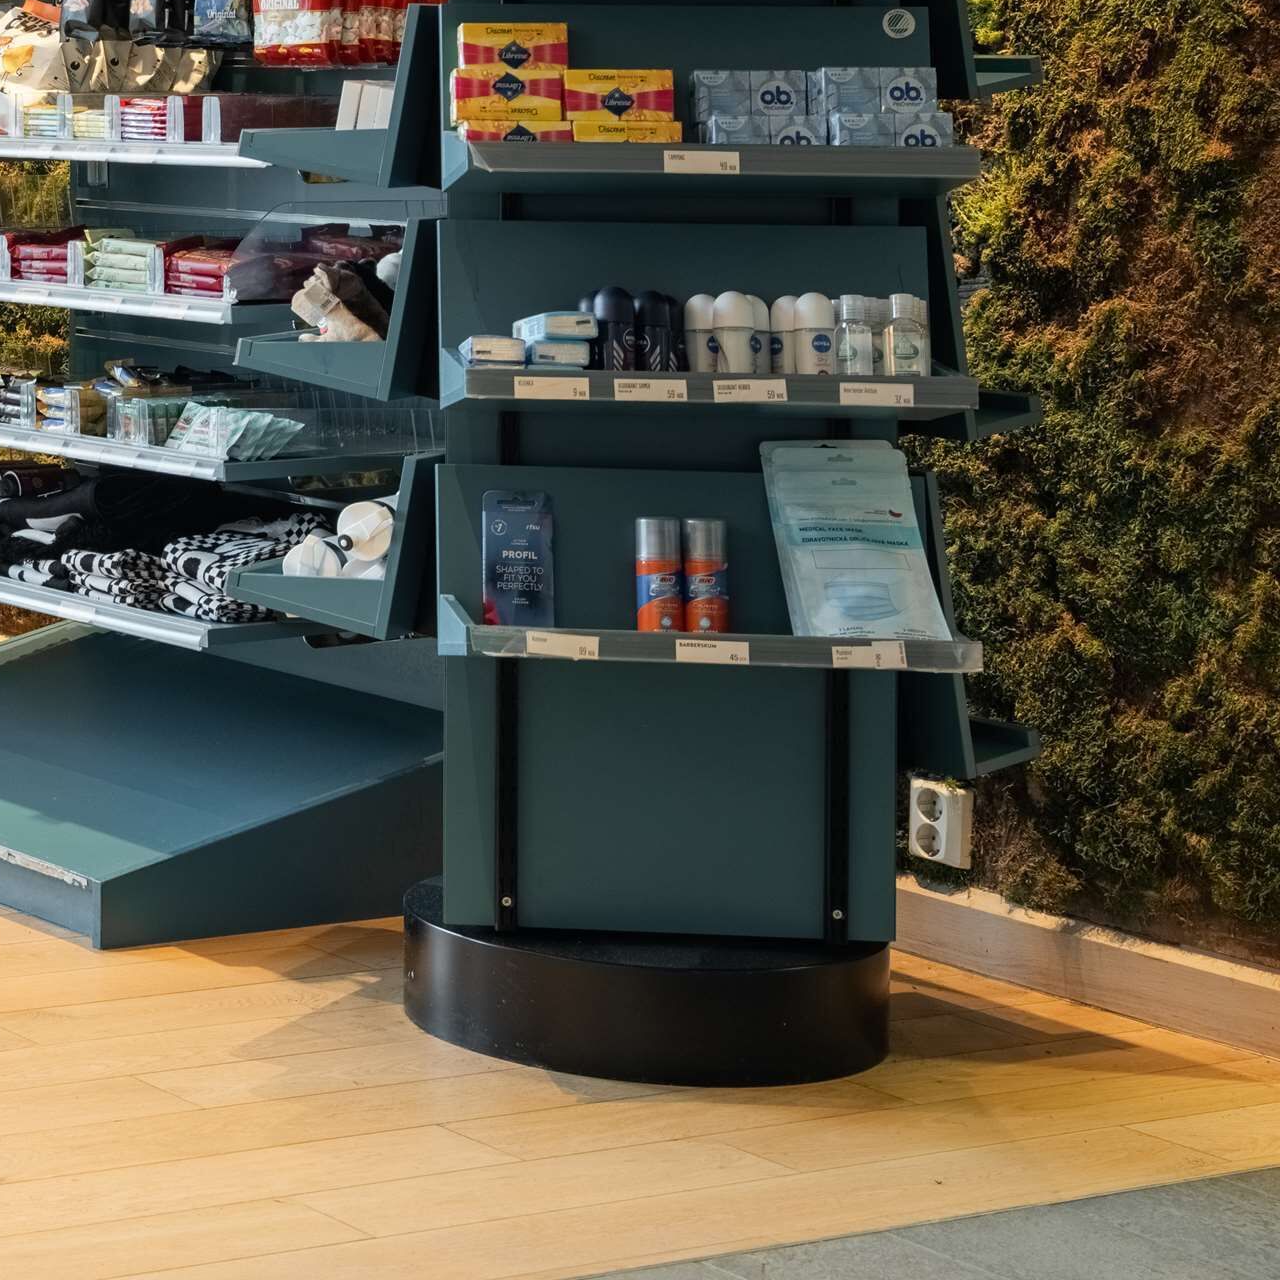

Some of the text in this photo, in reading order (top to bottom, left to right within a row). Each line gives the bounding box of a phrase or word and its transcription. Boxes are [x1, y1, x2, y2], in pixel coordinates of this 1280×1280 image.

[760, 85, 793, 105] o.b.
[889, 81, 923, 101] o.b.
[502, 550, 538, 560] PROFIL
[496, 565, 544, 575] SHAPED TO
[517, 574, 537, 583] YOU
[496, 581, 544, 591] PERFECTLY
